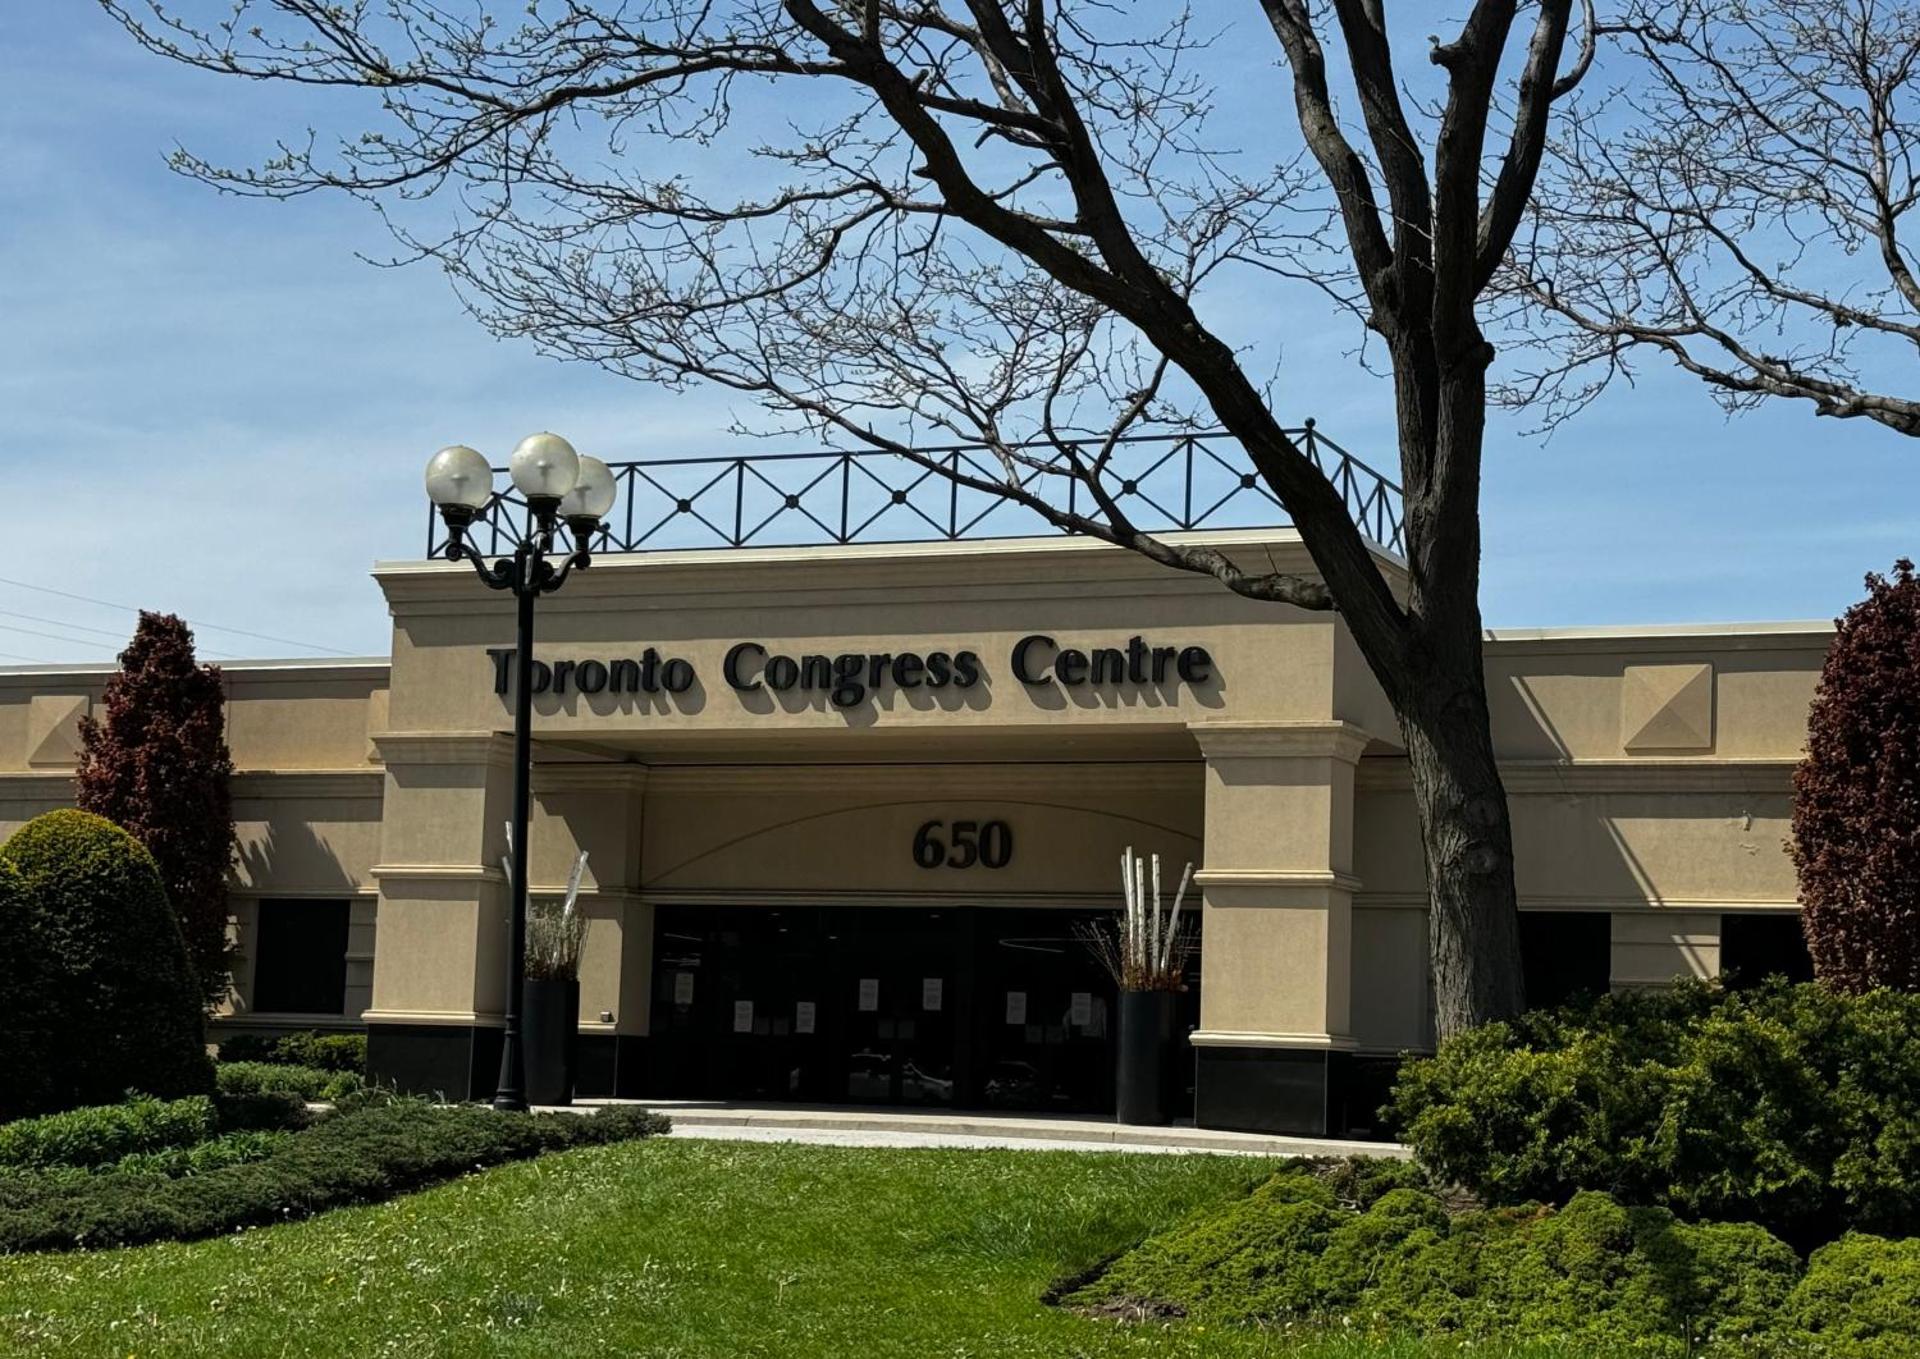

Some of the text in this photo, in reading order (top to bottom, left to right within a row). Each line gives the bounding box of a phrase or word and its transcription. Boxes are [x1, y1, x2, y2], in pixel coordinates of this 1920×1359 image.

[486, 635, 1211, 707] Toronto Congress Centre
[912, 820, 1013, 869] 650
